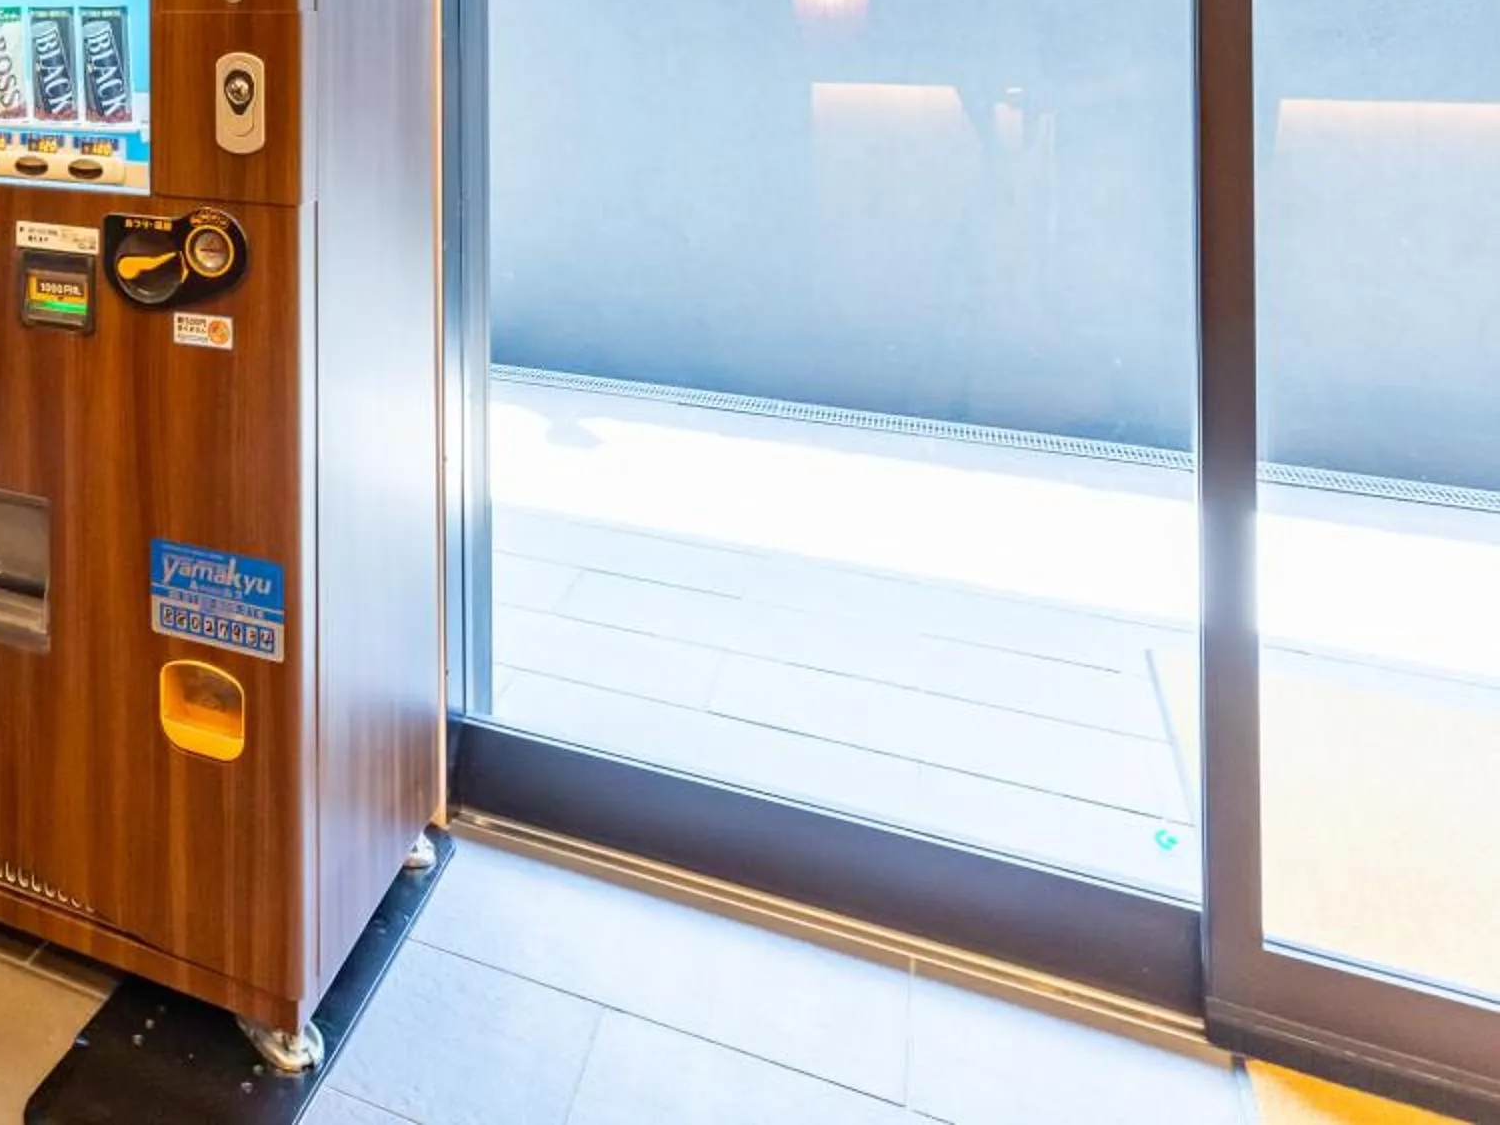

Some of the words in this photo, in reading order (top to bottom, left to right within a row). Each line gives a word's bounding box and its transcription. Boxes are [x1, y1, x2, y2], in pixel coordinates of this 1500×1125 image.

[35, 25, 74, 115] BLACK
[87, 28, 127, 117] BLACK
[162, 552, 273, 596] yamakyu
